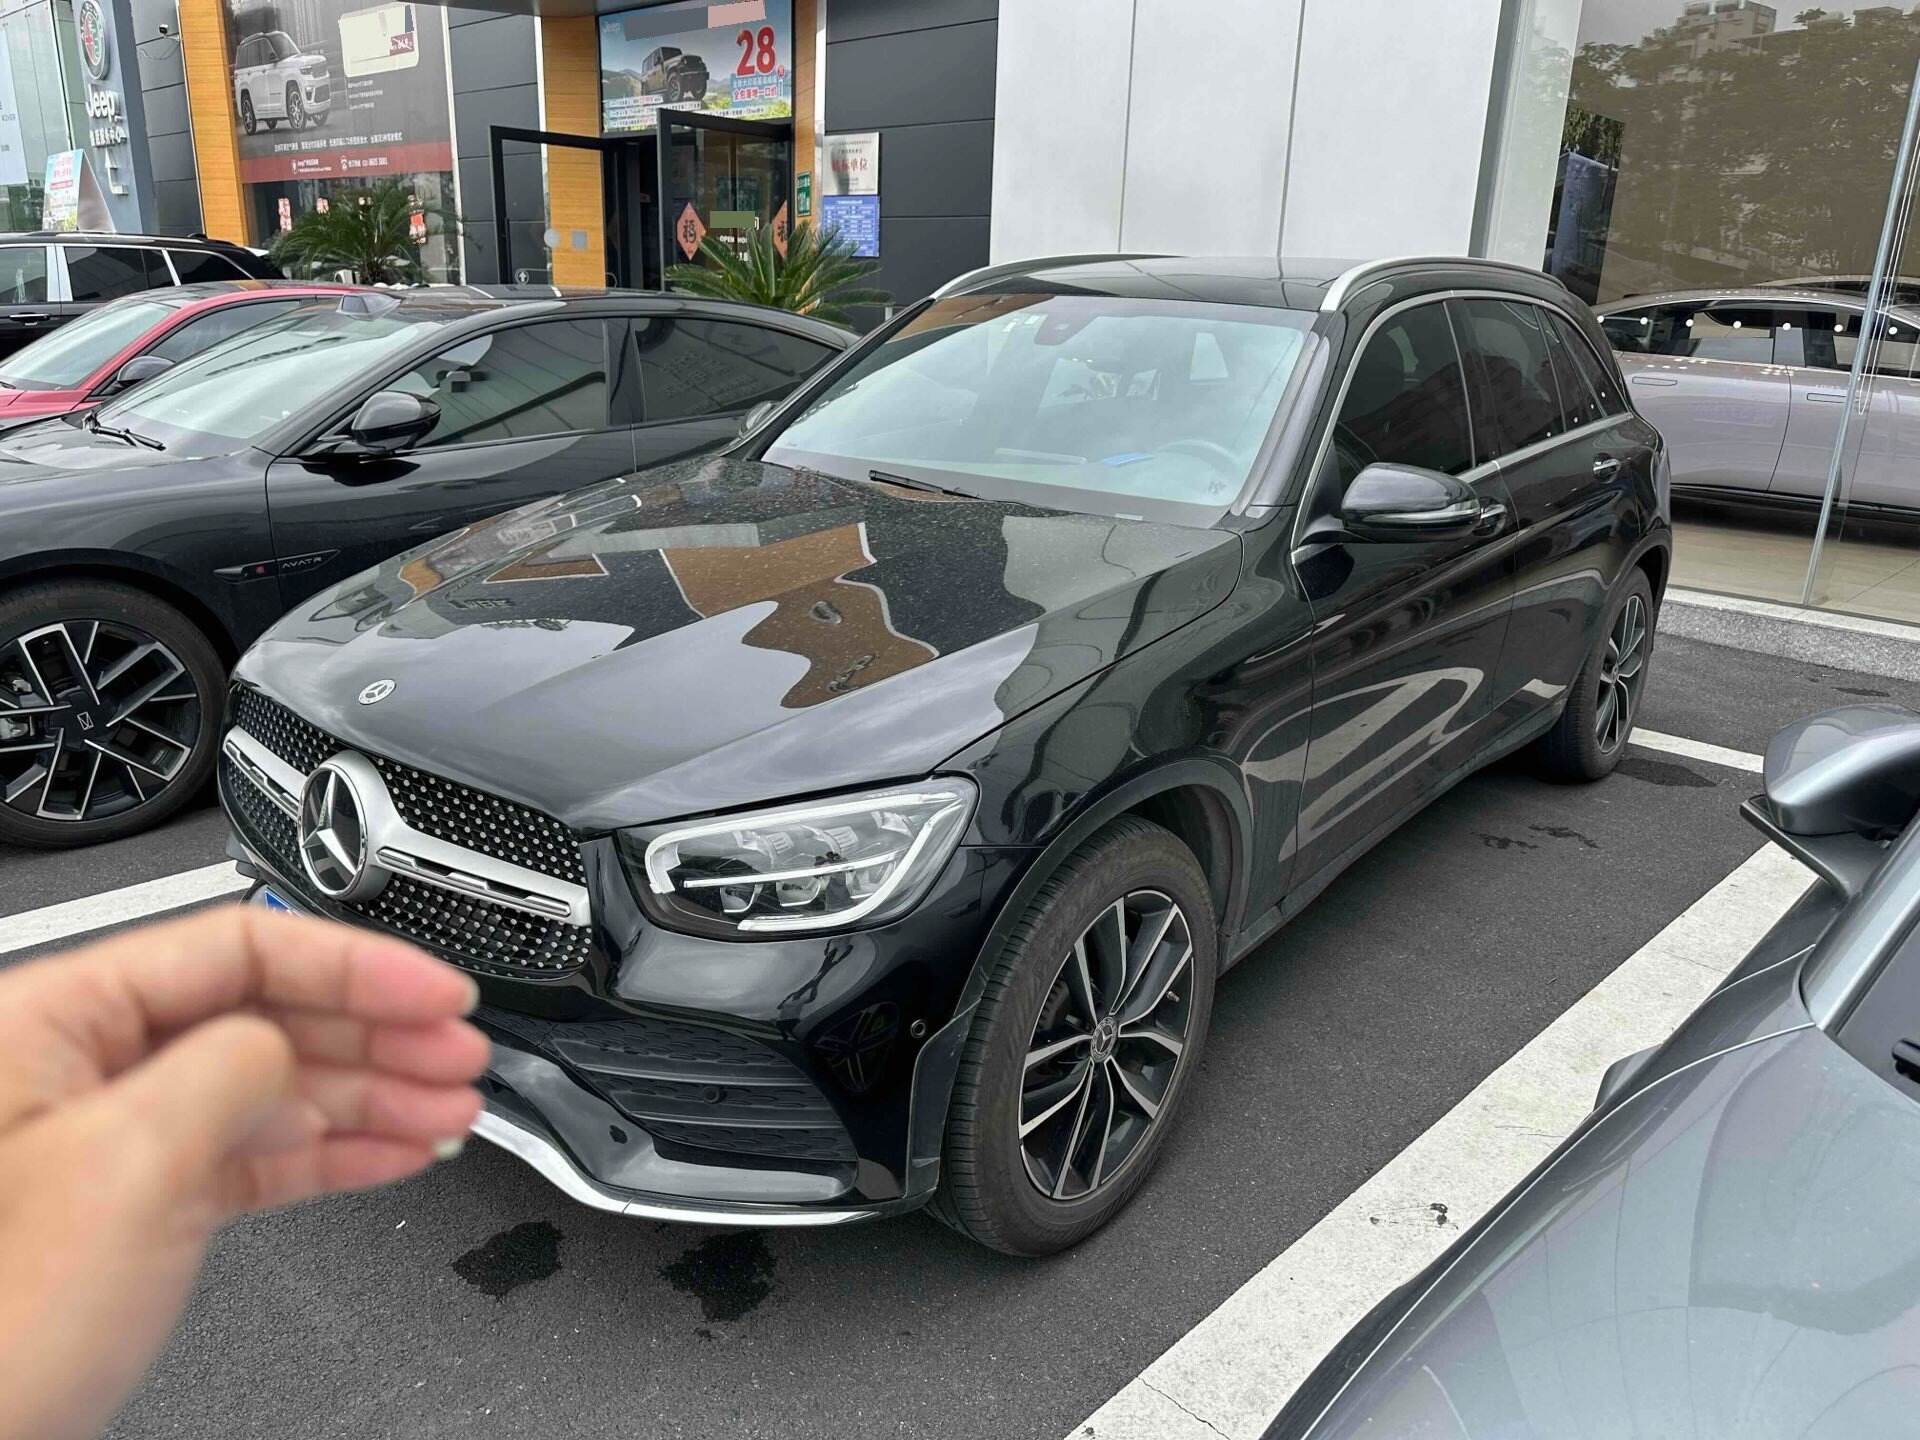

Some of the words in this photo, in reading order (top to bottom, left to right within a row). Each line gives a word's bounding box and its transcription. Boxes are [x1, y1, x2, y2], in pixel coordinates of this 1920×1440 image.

[736, 26, 776, 76] 28
[86, 84, 115, 122] Jeep
[720, 235, 735, 243] OPEN
